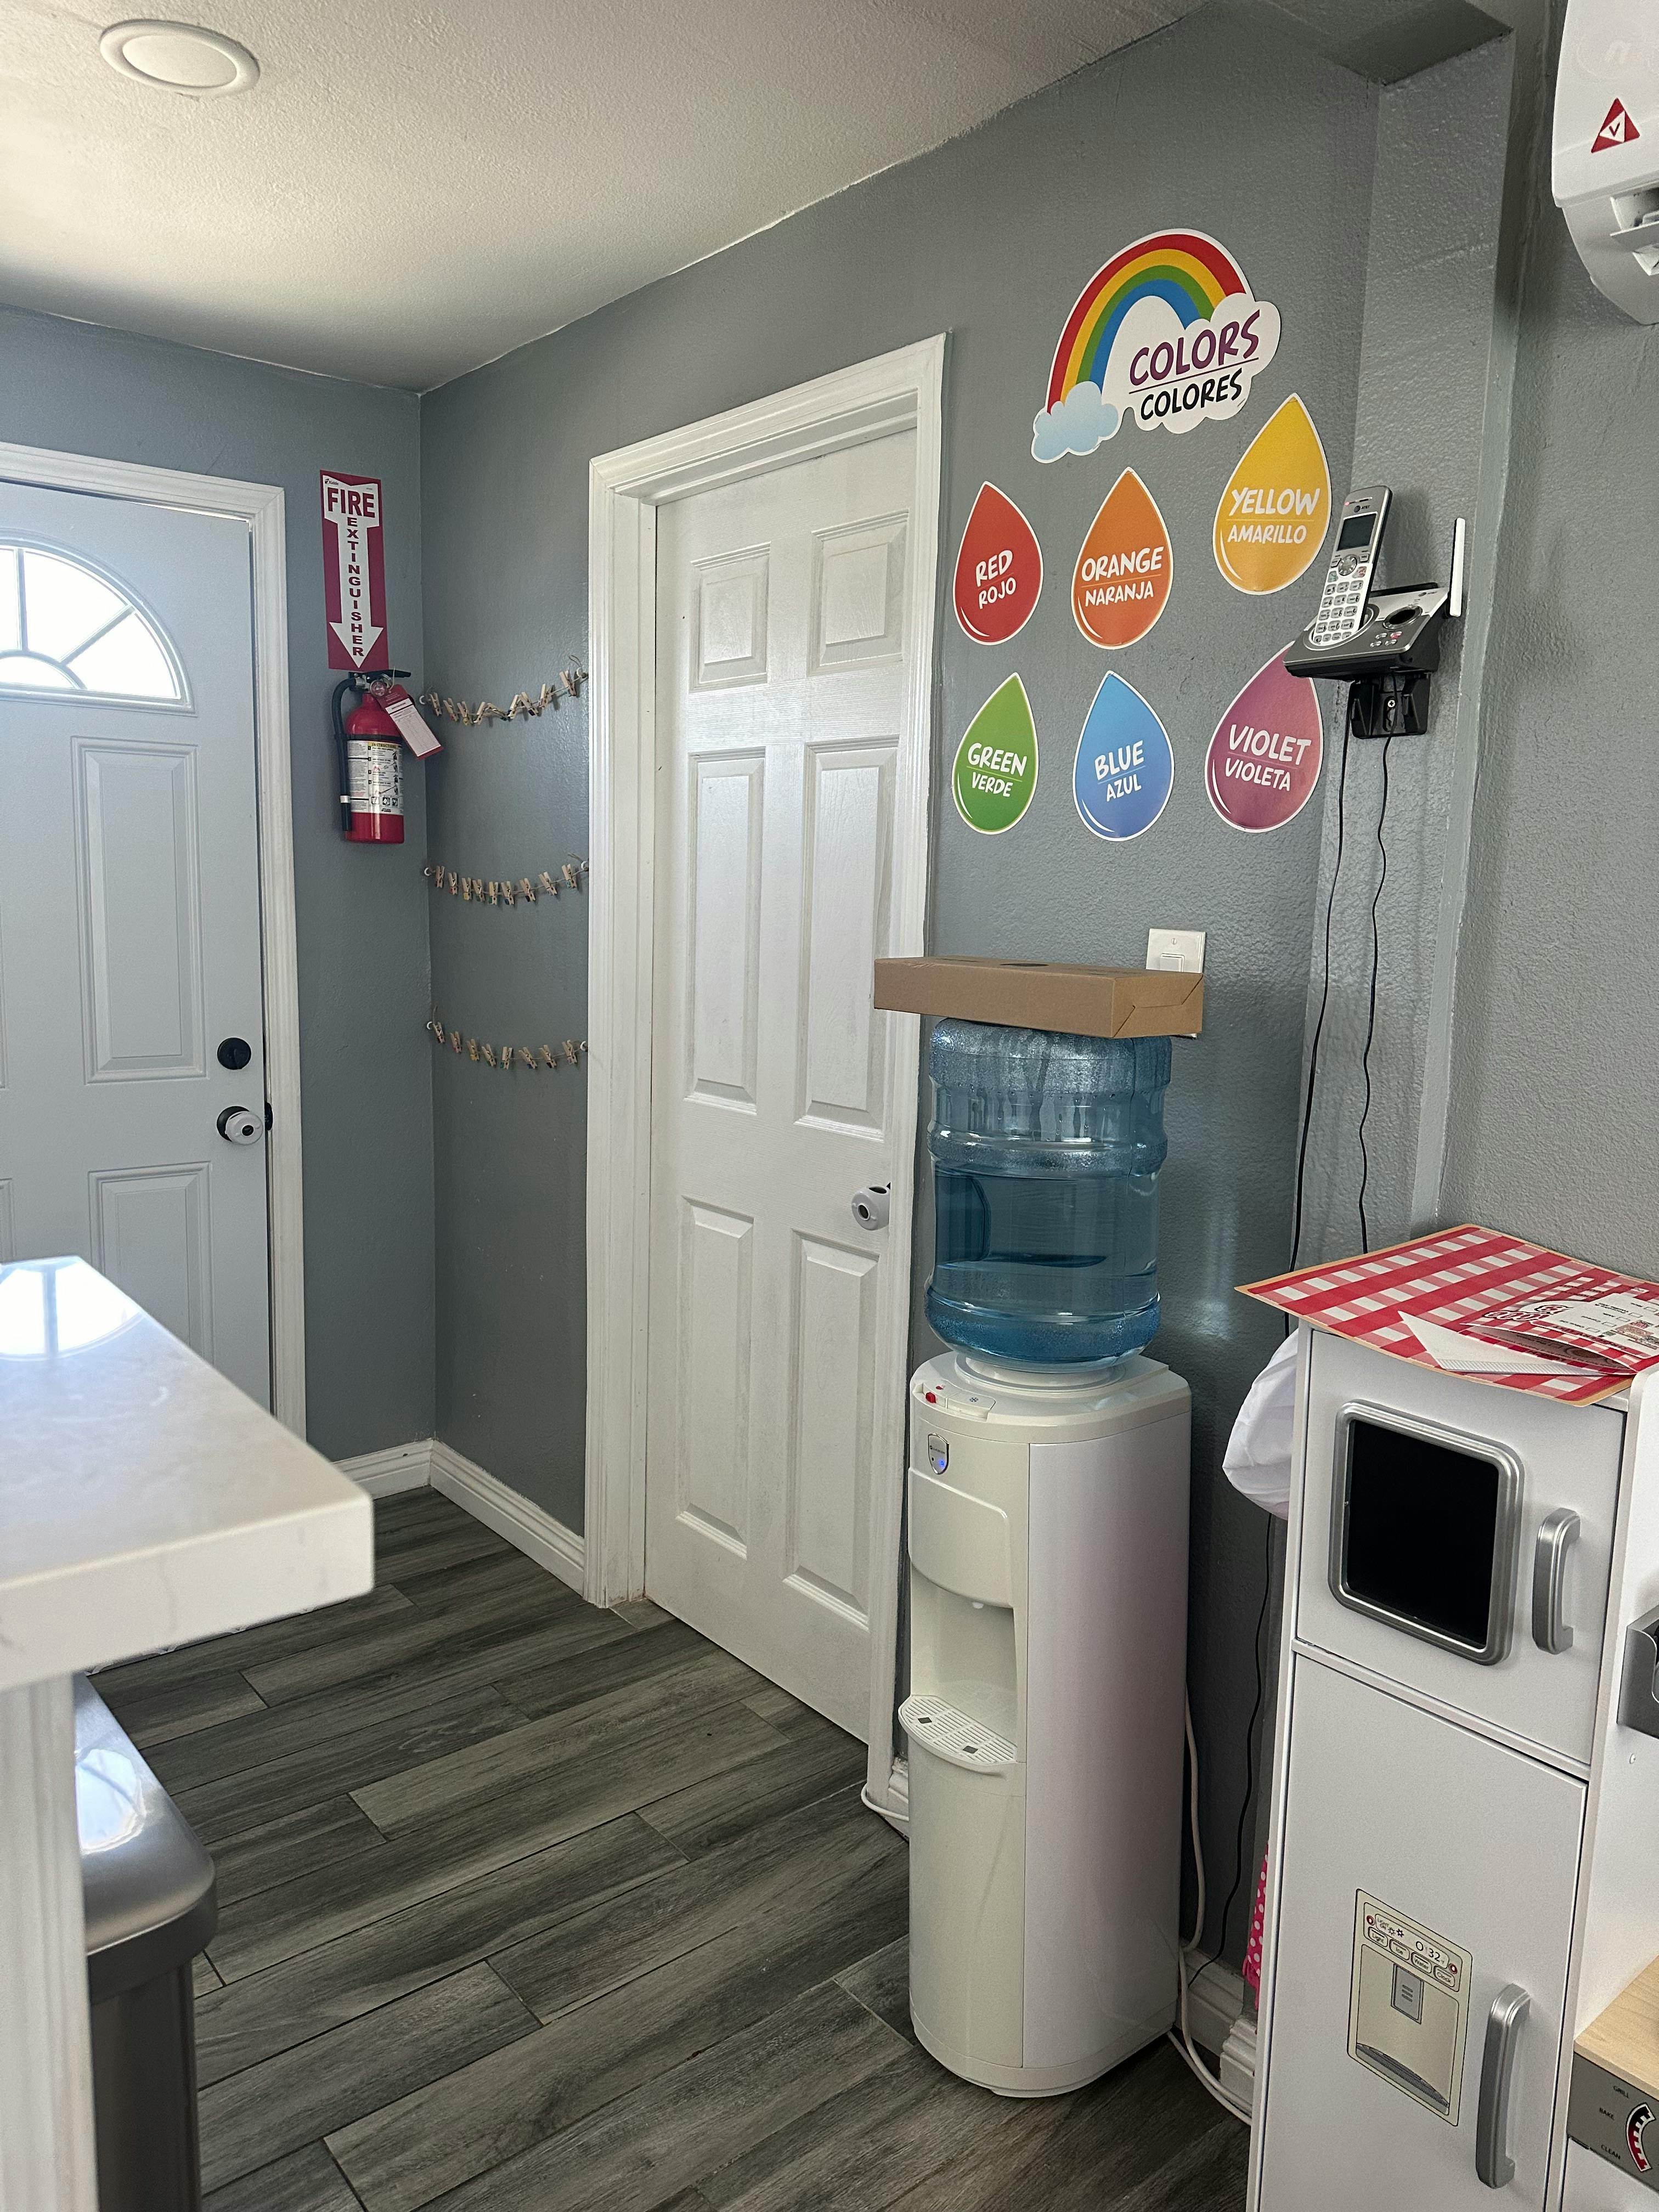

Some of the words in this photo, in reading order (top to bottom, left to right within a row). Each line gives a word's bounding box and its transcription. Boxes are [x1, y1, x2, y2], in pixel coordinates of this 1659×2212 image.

[1130, 309, 1260, 386] COLORS
[1141, 368, 1243, 421] COLORES
[327, 487, 375, 518] FIRE
[1229, 487, 1321, 516] YELLOW
[1227, 524, 1307, 544] AMARILLO
[975, 550, 1013, 586] RED
[1081, 546, 1164, 582] ORANGE
[346, 516, 364, 657] EXTINGUISHER
[979, 577, 1016, 610] ROJO
[1085, 580, 1154, 607] NARANJA
[968, 742, 1028, 777] GREEN
[1229, 724, 1312, 765] VIOLET
[1094, 740, 1145, 781] BLUE
[1225, 758, 1291, 792] VIOLETA
[972, 772, 1013, 797] VERDE
[1105, 774, 1142, 802] AZUL
[1373, 1933, 1384, 1943] Light
[1414, 1959, 1429, 1970] Water
[1437, 1972, 1451, 1984] Clock
[1613, 2086, 1629, 2099] GRILL
[1599, 2107, 1614, 2120] BAKE
[1601, 2144, 1621, 2160] CLEAN
